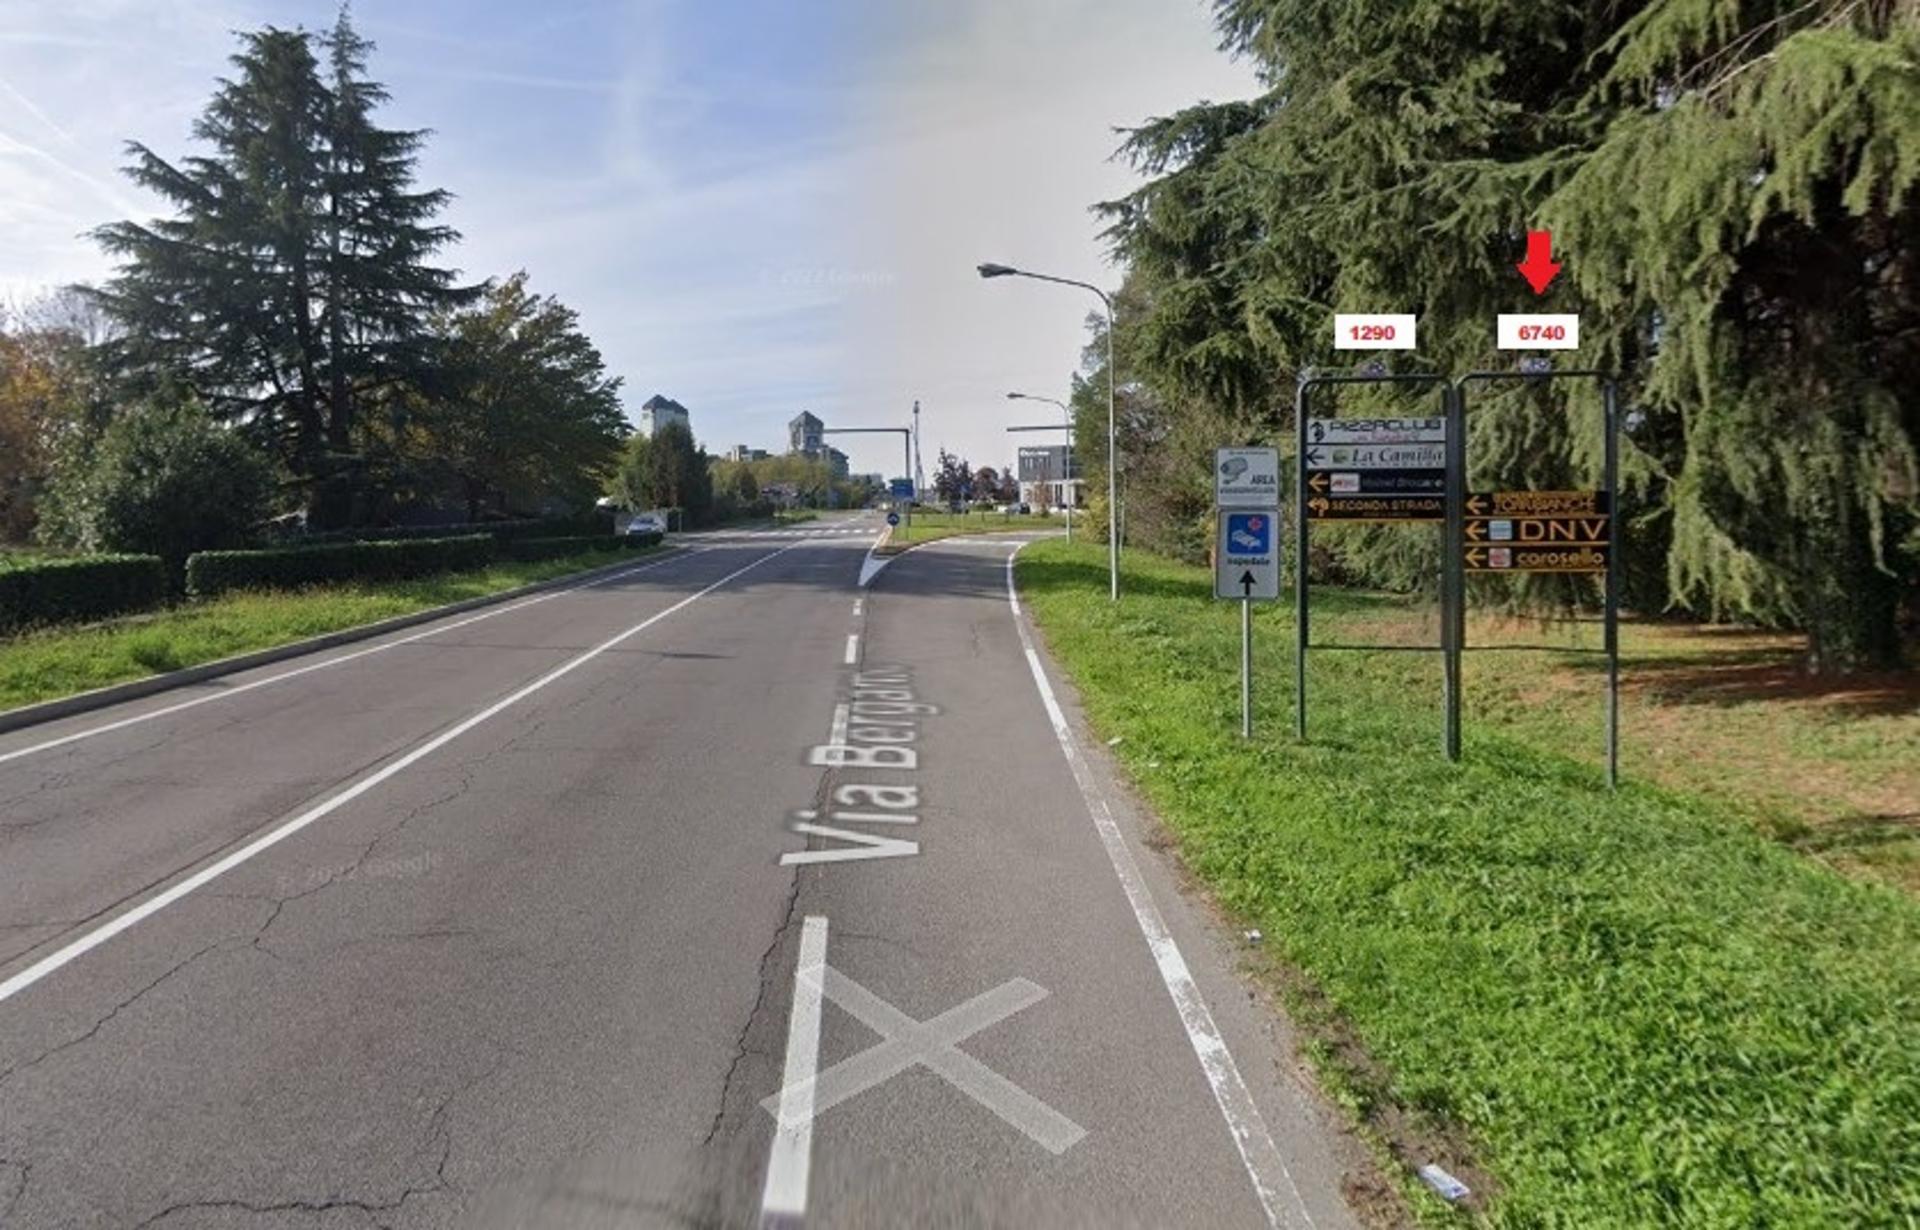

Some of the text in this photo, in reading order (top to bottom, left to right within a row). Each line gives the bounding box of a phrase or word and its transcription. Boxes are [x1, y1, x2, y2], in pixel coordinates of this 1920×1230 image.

[1352, 447, 1443, 462] La Camilla
[1331, 499, 1441, 511] SECONDA STRADA
[1520, 519, 1605, 541] DNV
